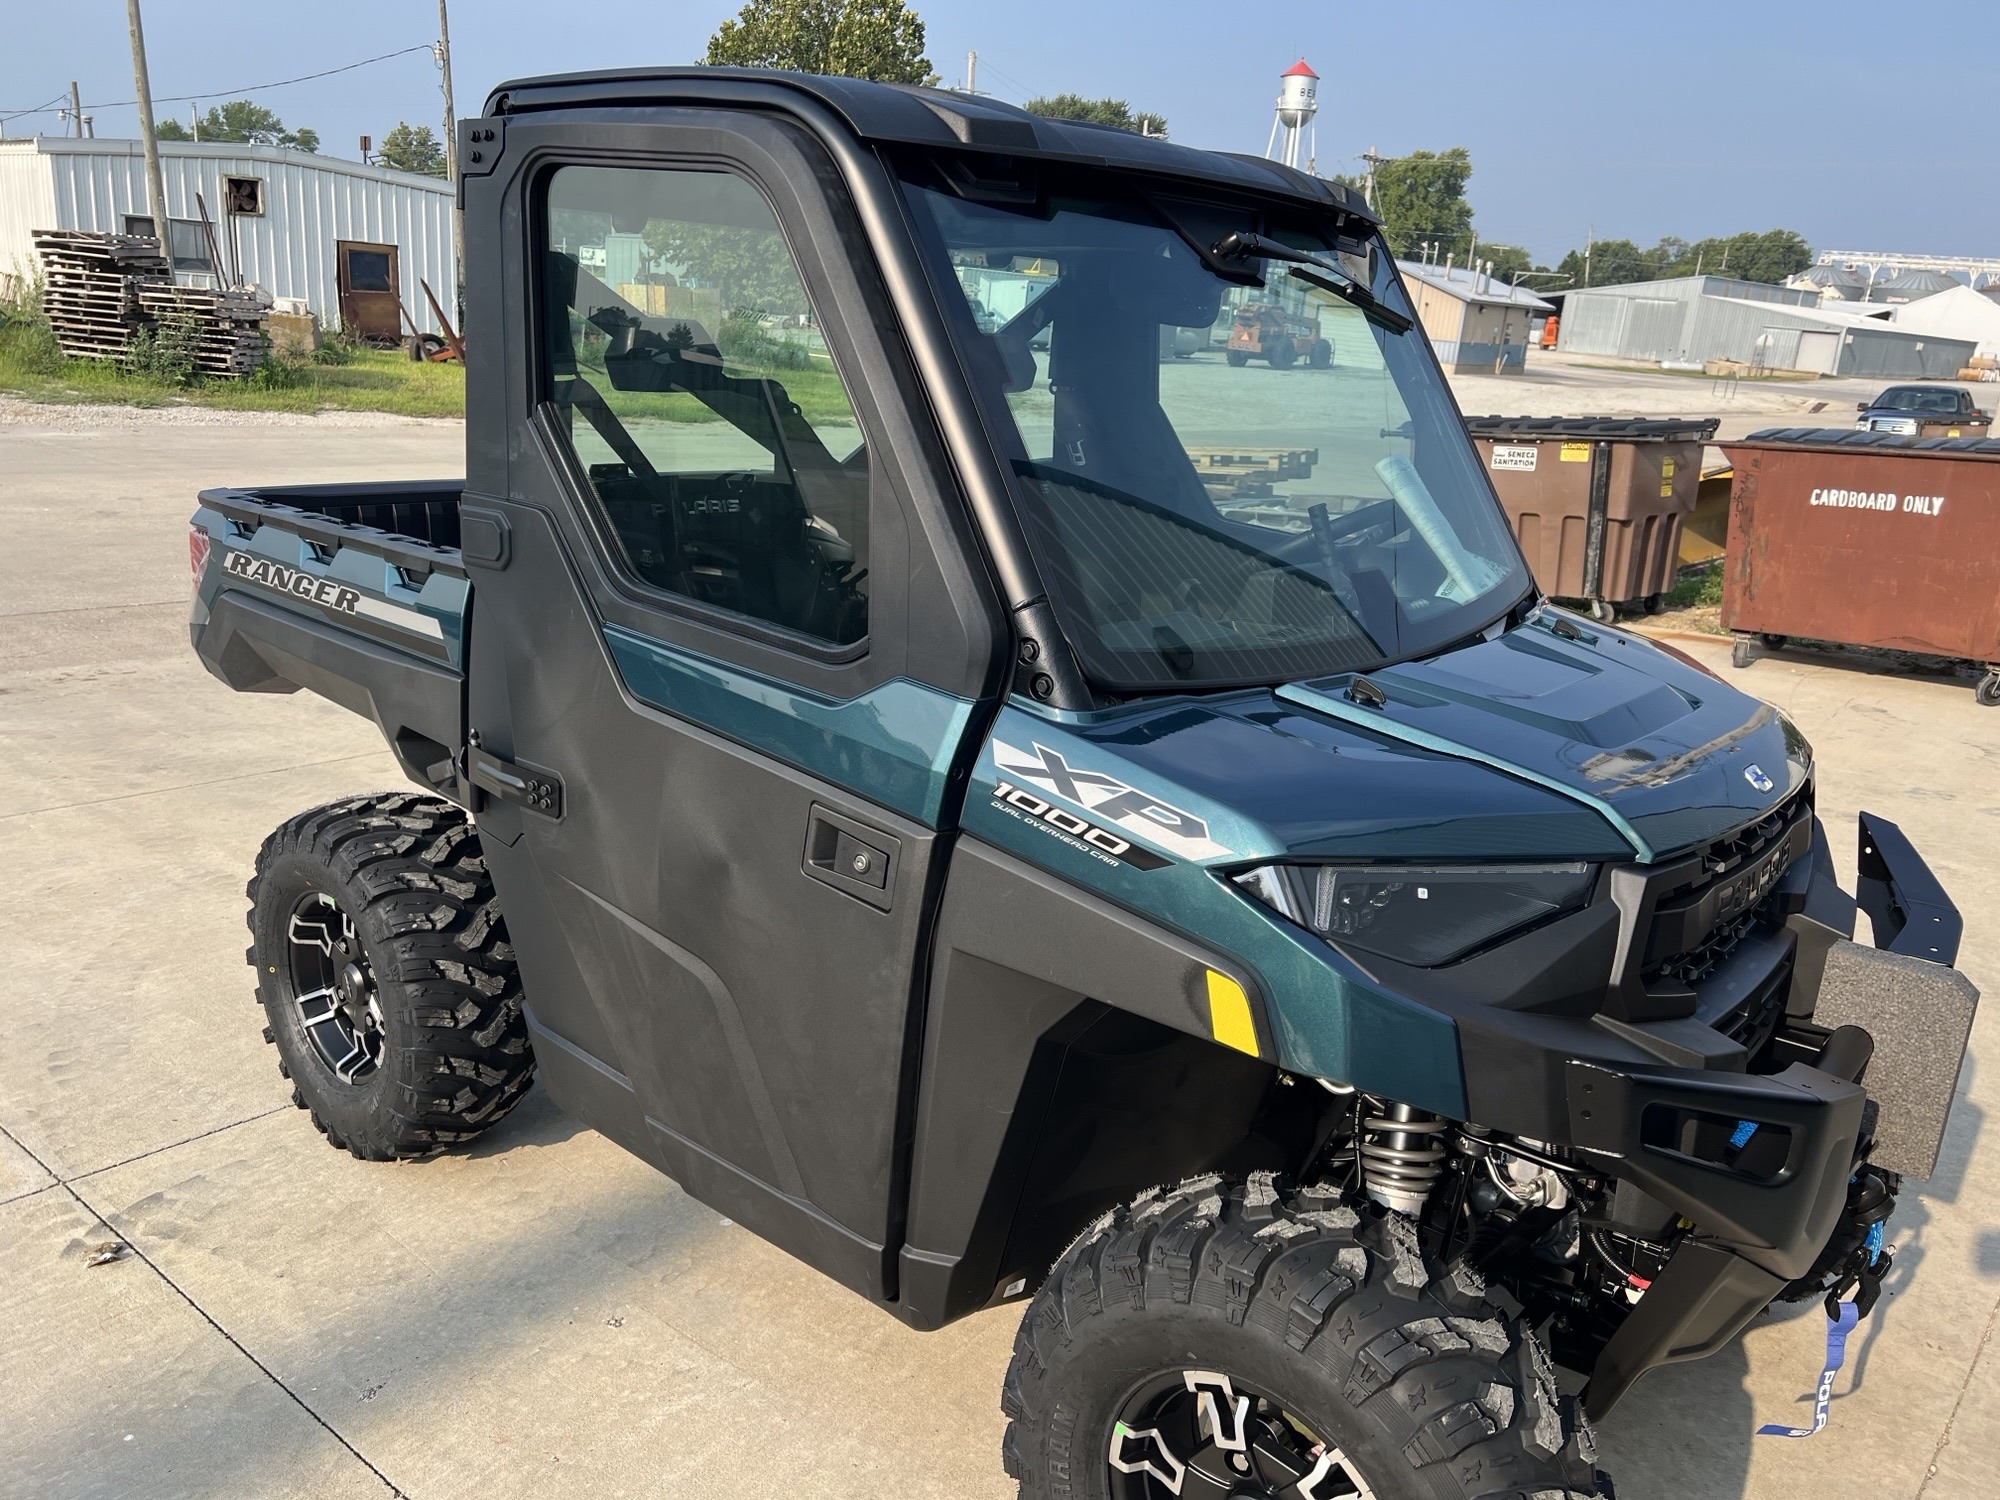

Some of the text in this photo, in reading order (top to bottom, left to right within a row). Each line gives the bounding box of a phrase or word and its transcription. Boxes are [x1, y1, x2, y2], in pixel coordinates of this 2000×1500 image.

[1493, 458, 1535, 467] SANITATION
[1507, 451, 1536, 459] SENECA
[650, 498, 741, 518] PLARIS
[1810, 489, 1945, 517] CARDBOARD ONLY
[228, 551, 362, 615] RANGER
[992, 781, 1131, 855] 1000
[997, 742, 1211, 840] XP
[990, 800, 1120, 868] DUAL OVERHEAD CAM
[1787, 1370, 1837, 1437] POLAIS
